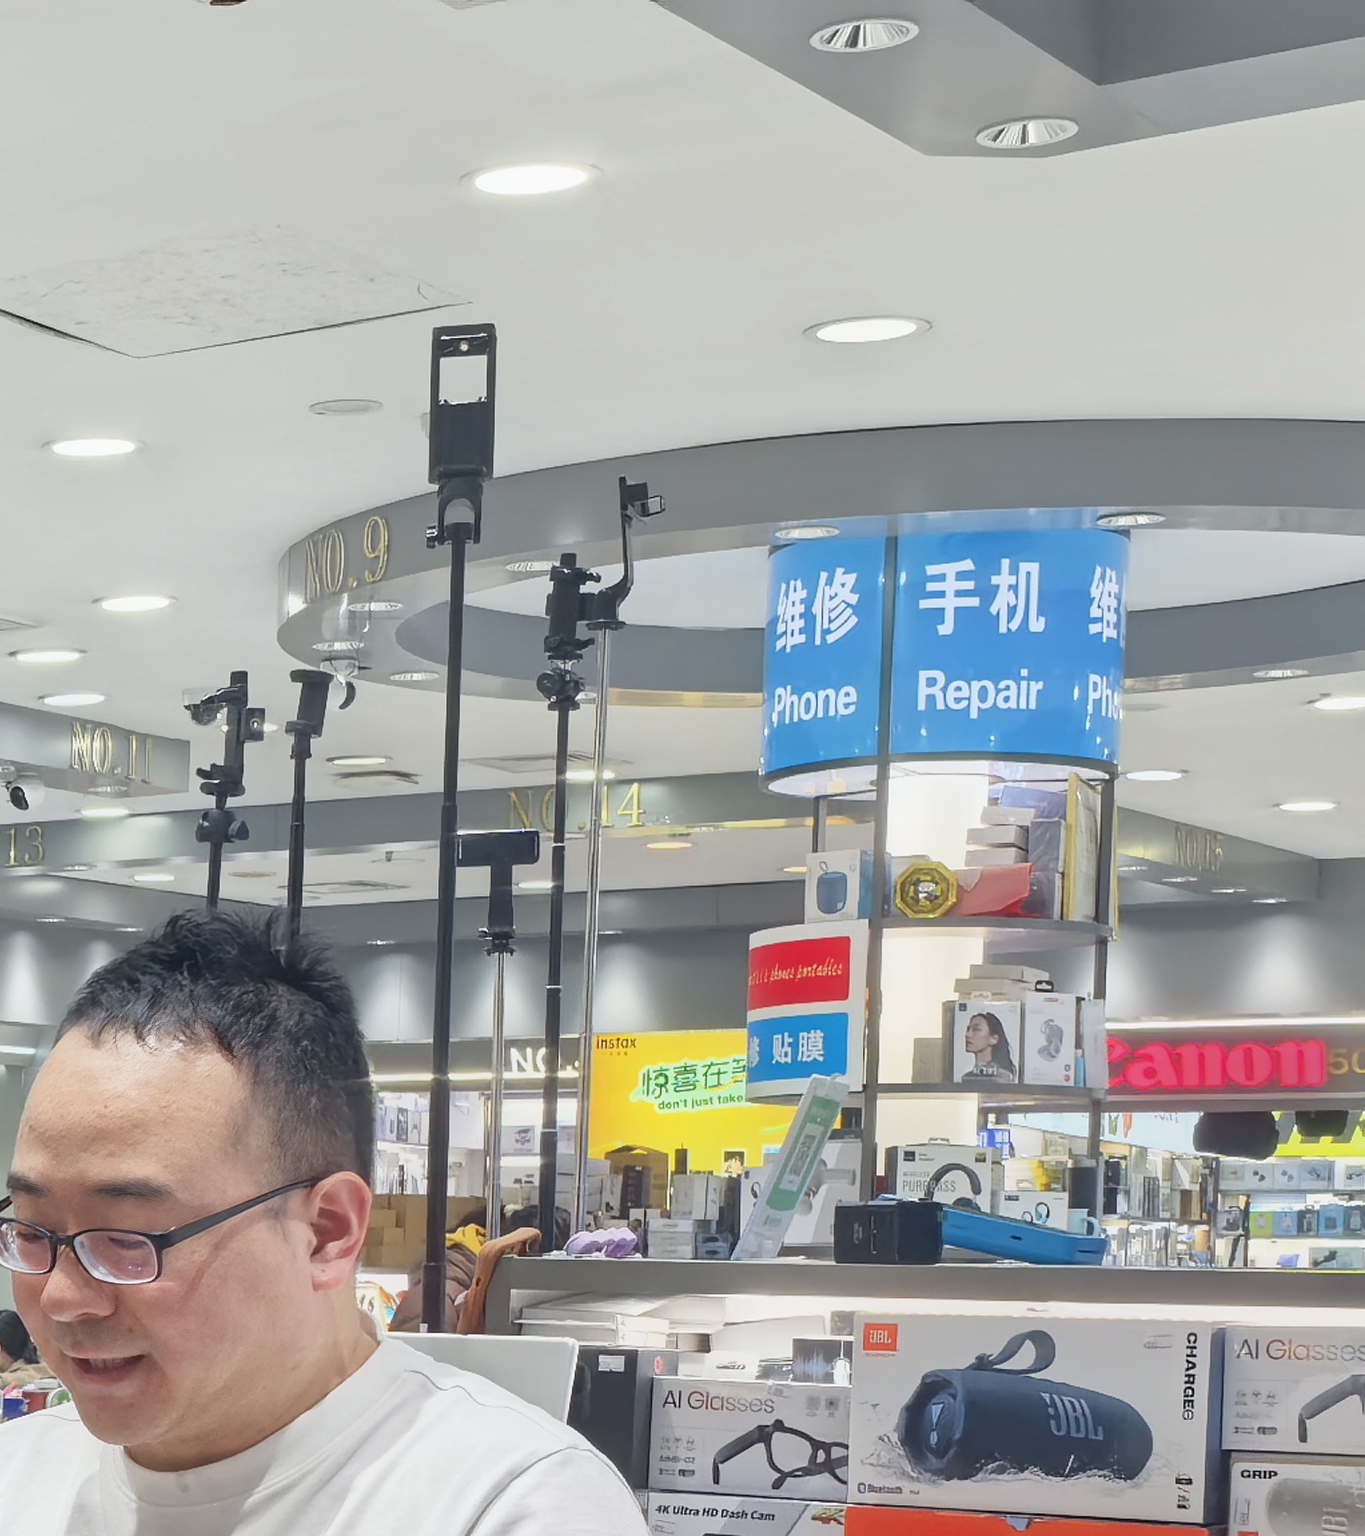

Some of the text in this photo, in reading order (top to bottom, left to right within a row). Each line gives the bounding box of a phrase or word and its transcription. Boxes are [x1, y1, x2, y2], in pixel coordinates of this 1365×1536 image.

[303, 516, 388, 604] NO.9
[776, 558, 1125, 652] 维修 手机 维
[772, 684, 857, 725] Phone
[918, 668, 1044, 719] Repair
[71, 721, 153, 784] NO.11
[596, 1036, 637, 1050] instax
[772, 1029, 824, 1064] 贴膜
[658, 1096, 688, 1110] don't
[691, 1095, 713, 1110] just
[869, 1329, 892, 1345] JBL
[1236, 1339, 1259, 1360] AI
[663, 1390, 776, 1414] AI Glasses
[1040, 1391, 1104, 1441] JBL
[1240, 1469, 1278, 1480] GRIP
[655, 1504, 776, 1522] 4K Ultra HD Dash Cam
